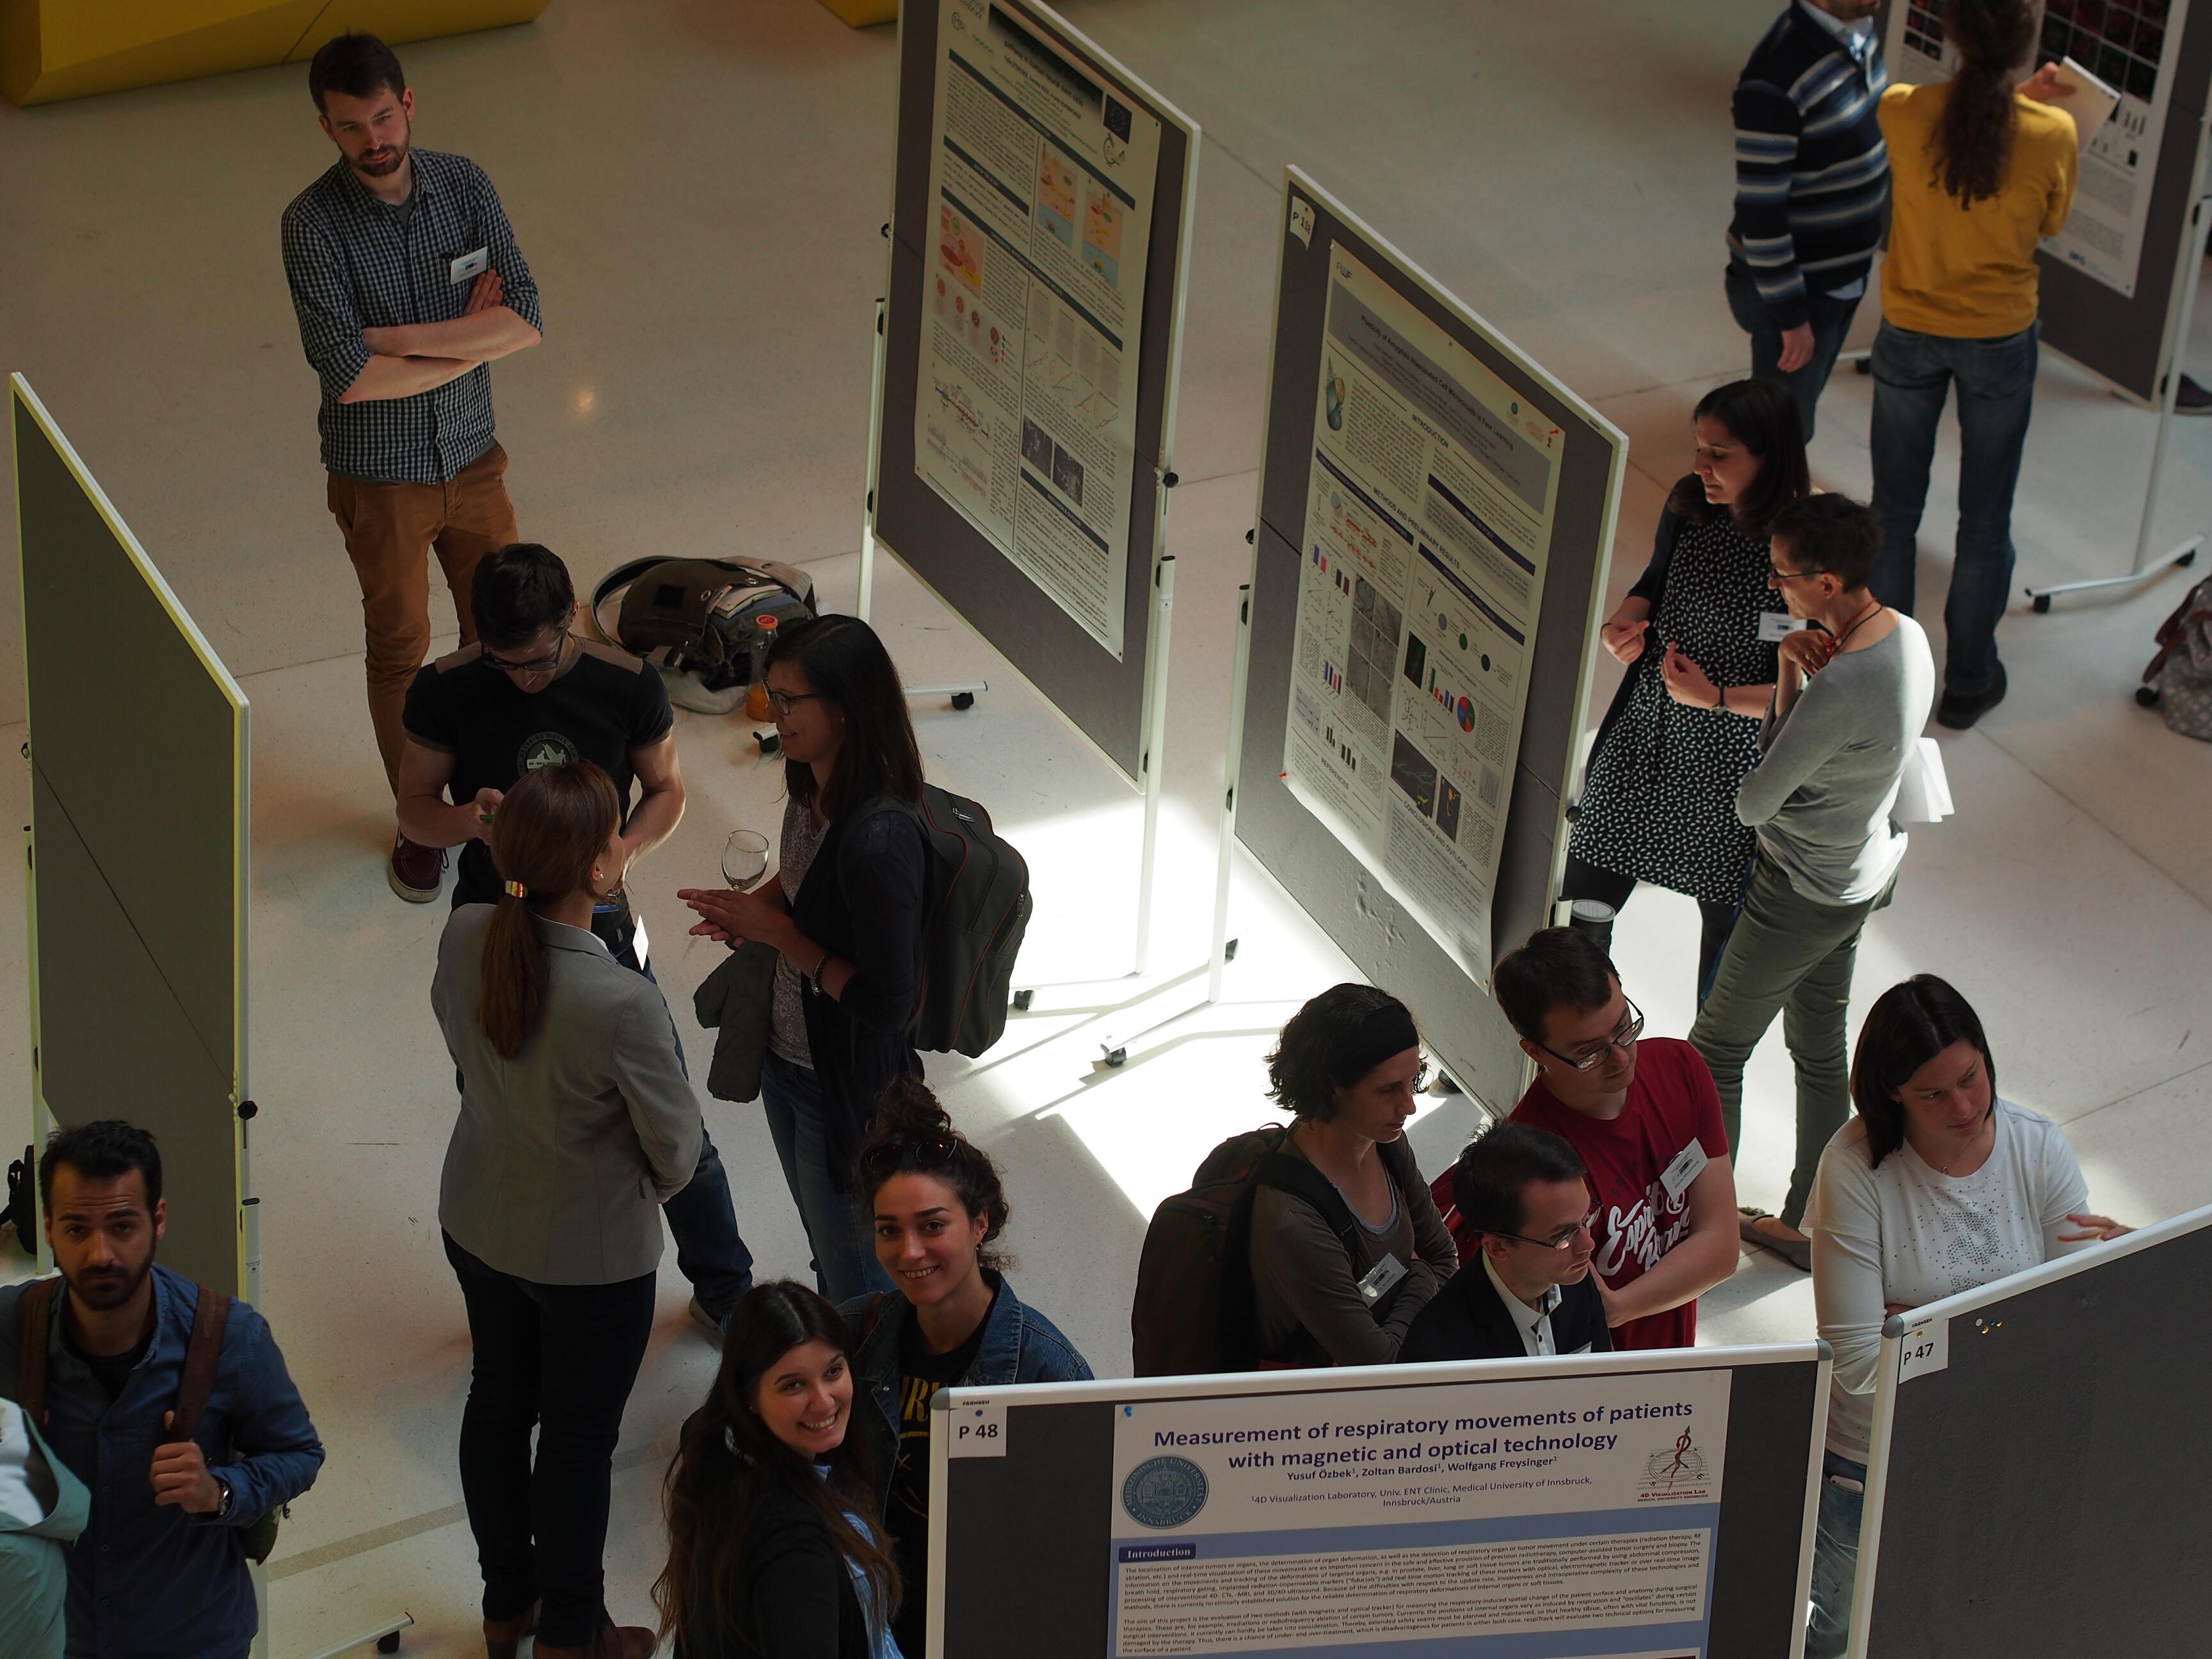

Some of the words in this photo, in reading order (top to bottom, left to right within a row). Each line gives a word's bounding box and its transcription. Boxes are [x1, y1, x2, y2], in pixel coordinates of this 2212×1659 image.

[1293, 211, 1299, 221] P
[1412, 412, 1448, 451] INTRODUCTION
[1373, 485, 1397, 513] METHODS
[1397, 506, 1407, 522] AND
[1407, 516, 1439, 552] PRELIMINARY
[1439, 545, 1460, 570] RESULTS
[1321, 756, 1349, 791] REFERENCES
[1404, 799, 1435, 838] CONCLUSIONS
[1436, 831, 1445, 849] AND
[1445, 842, 1468, 871] OUTLOOK
[1903, 1351, 1911, 1365] P
[1915, 1342, 1934, 1359] 47
[959, 1426, 970, 1439] P
[975, 1424, 998, 1438] 48
[1154, 1423, 1301, 1448] Measurement
[1308, 1422, 1329, 1439] of
[1335, 1416, 1449, 1441] respiratory
[1455, 1409, 1576, 1431] movements
[1582, 1406, 1605, 1423] of
[1609, 1400, 1693, 1424] patients
[1228, 1450, 1274, 1469] with
[1281, 1445, 1377, 1470] magnetic
[1382, 1442, 1421, 1460] and
[1427, 1438, 1497, 1461] optical
[1503, 1431, 1618, 1455] technology
[1286, 1470, 1316, 1480] Yusuf
[1361, 1466, 1395, 1477] Zoltan
[1447, 1460, 1497, 1474] Wolfgang
[1269, 1493, 1325, 1503] Visualization
[1327, 1489, 1377, 1501] Laboratory,
[1380, 1488, 1401, 1496] Univ.
[1404, 1487, 1421, 1495] ENT
[1423, 1485, 1450, 1495] Clinic,
[1452, 1482, 1487, 1492] Medical
[1489, 1480, 1534, 1491] University
[1535, 1479, 1545, 1487] of
[1547, 1476, 1592, 1487] Innsbruck,
[1382, 1495, 1461, 1507] Innsbruck/Austria
[1127, 1546, 1190, 1559] Introduction
